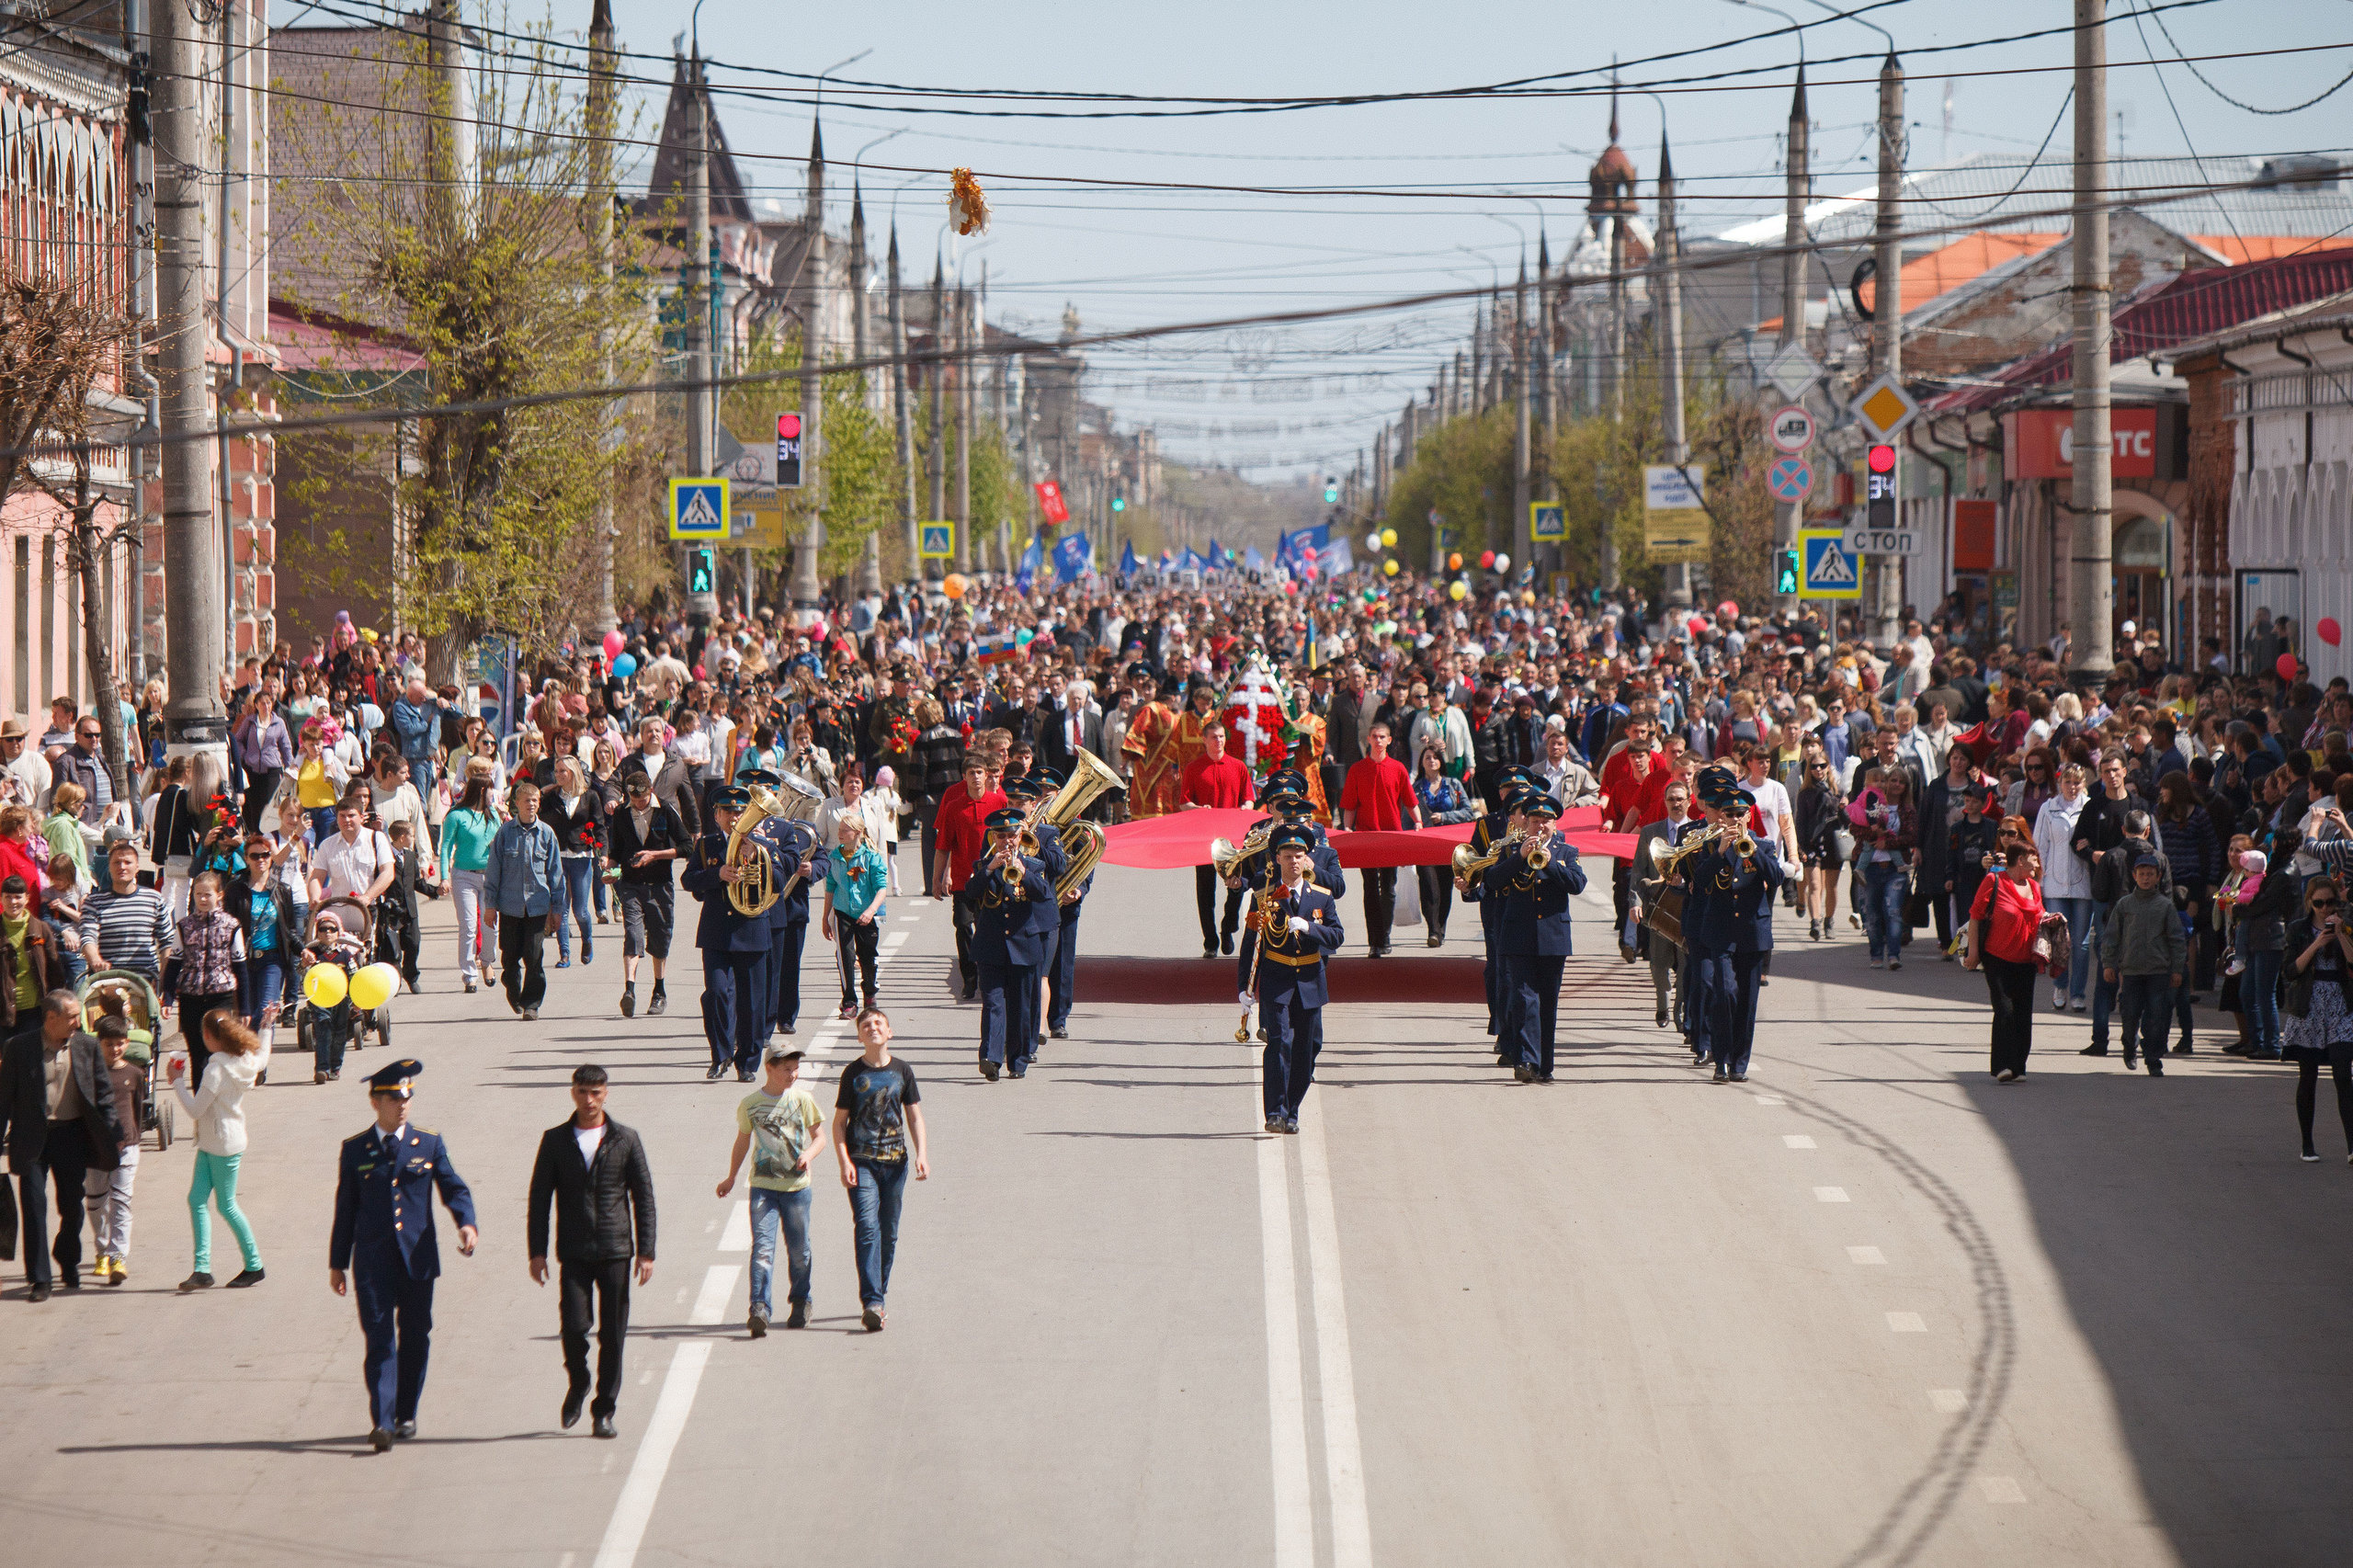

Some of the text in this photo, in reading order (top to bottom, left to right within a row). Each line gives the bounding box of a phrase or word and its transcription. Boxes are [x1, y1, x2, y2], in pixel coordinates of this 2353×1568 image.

[778, 439, 800, 460] 34
[2111, 431, 2151, 457] ТС
[1869, 474, 1895, 499] 34
[1854, 532, 1912, 551] СТОП
